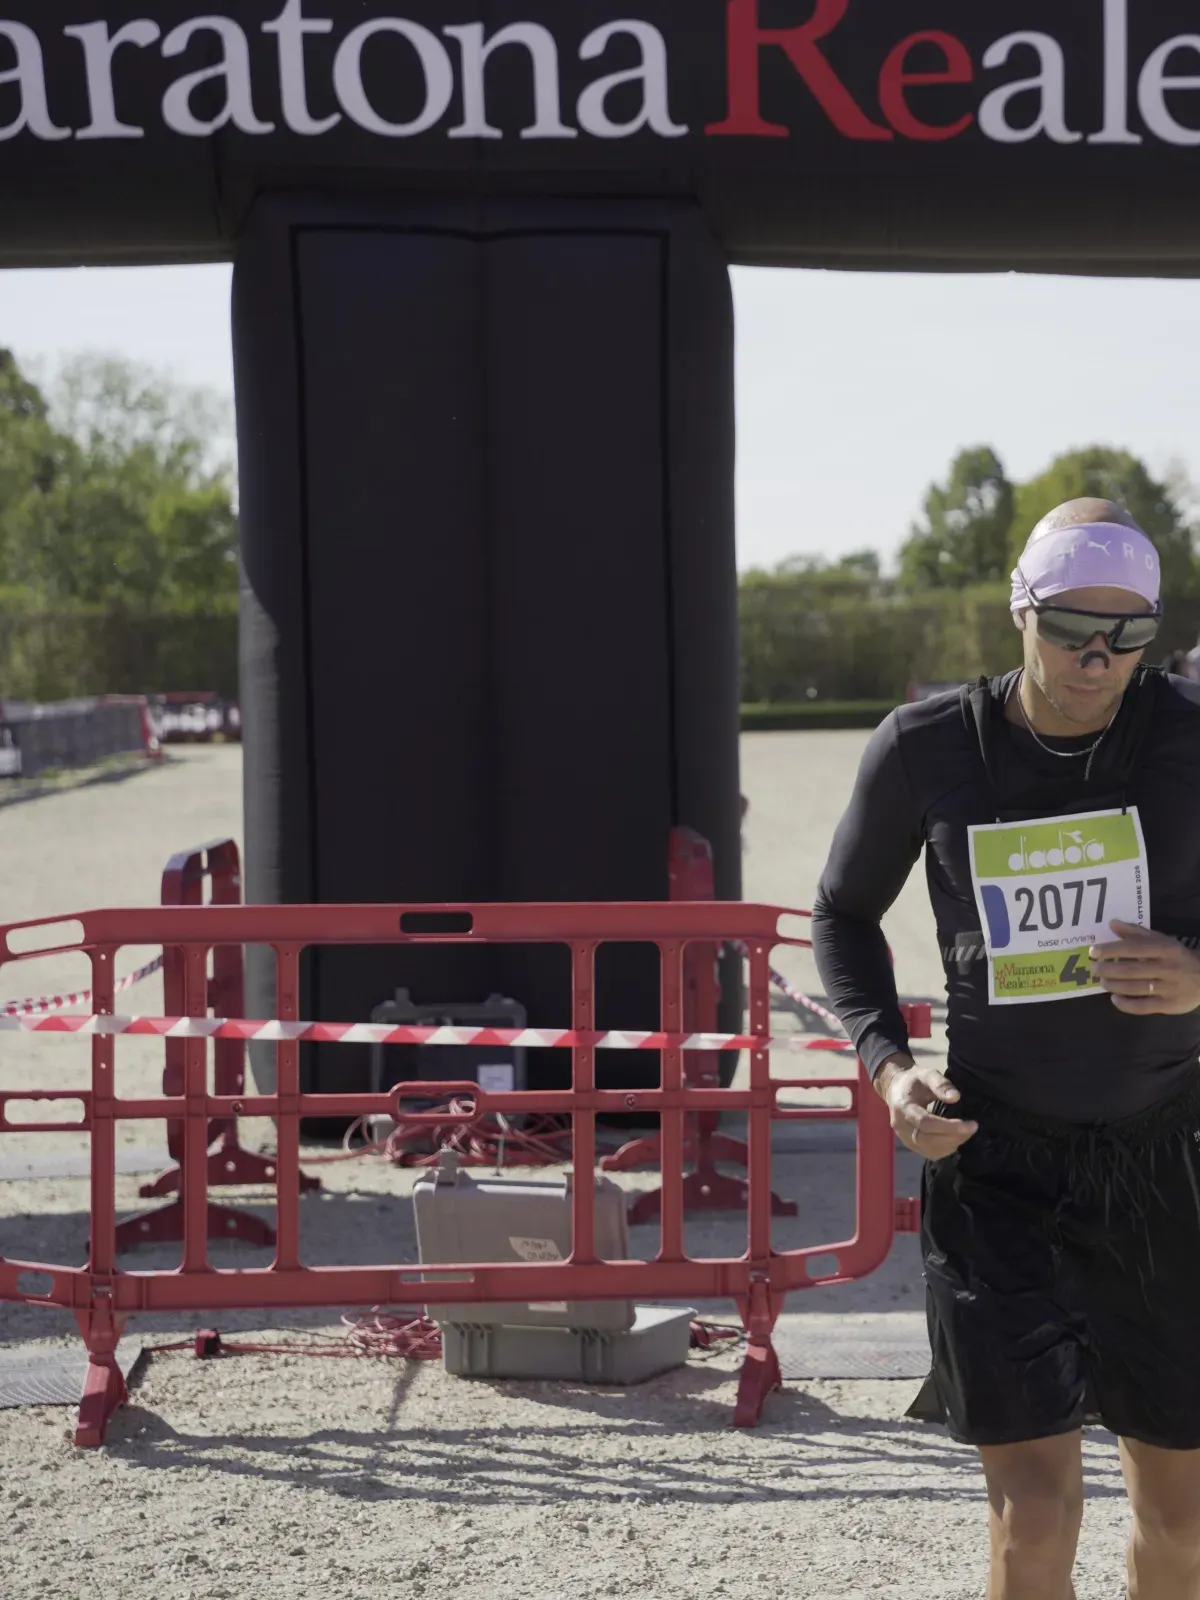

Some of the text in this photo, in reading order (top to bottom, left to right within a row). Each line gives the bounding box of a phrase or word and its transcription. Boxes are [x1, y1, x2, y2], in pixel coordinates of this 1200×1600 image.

[0, 0, 689, 140] aratona
[1008, 829, 1105, 872] diadora
[1014, 877, 1108, 932] 2077
[1037, 934, 1096, 948] base running
[999, 976, 1026, 990] Reale
[1003, 962, 1055, 977] Maratona
[1059, 954, 1101, 986] 4
